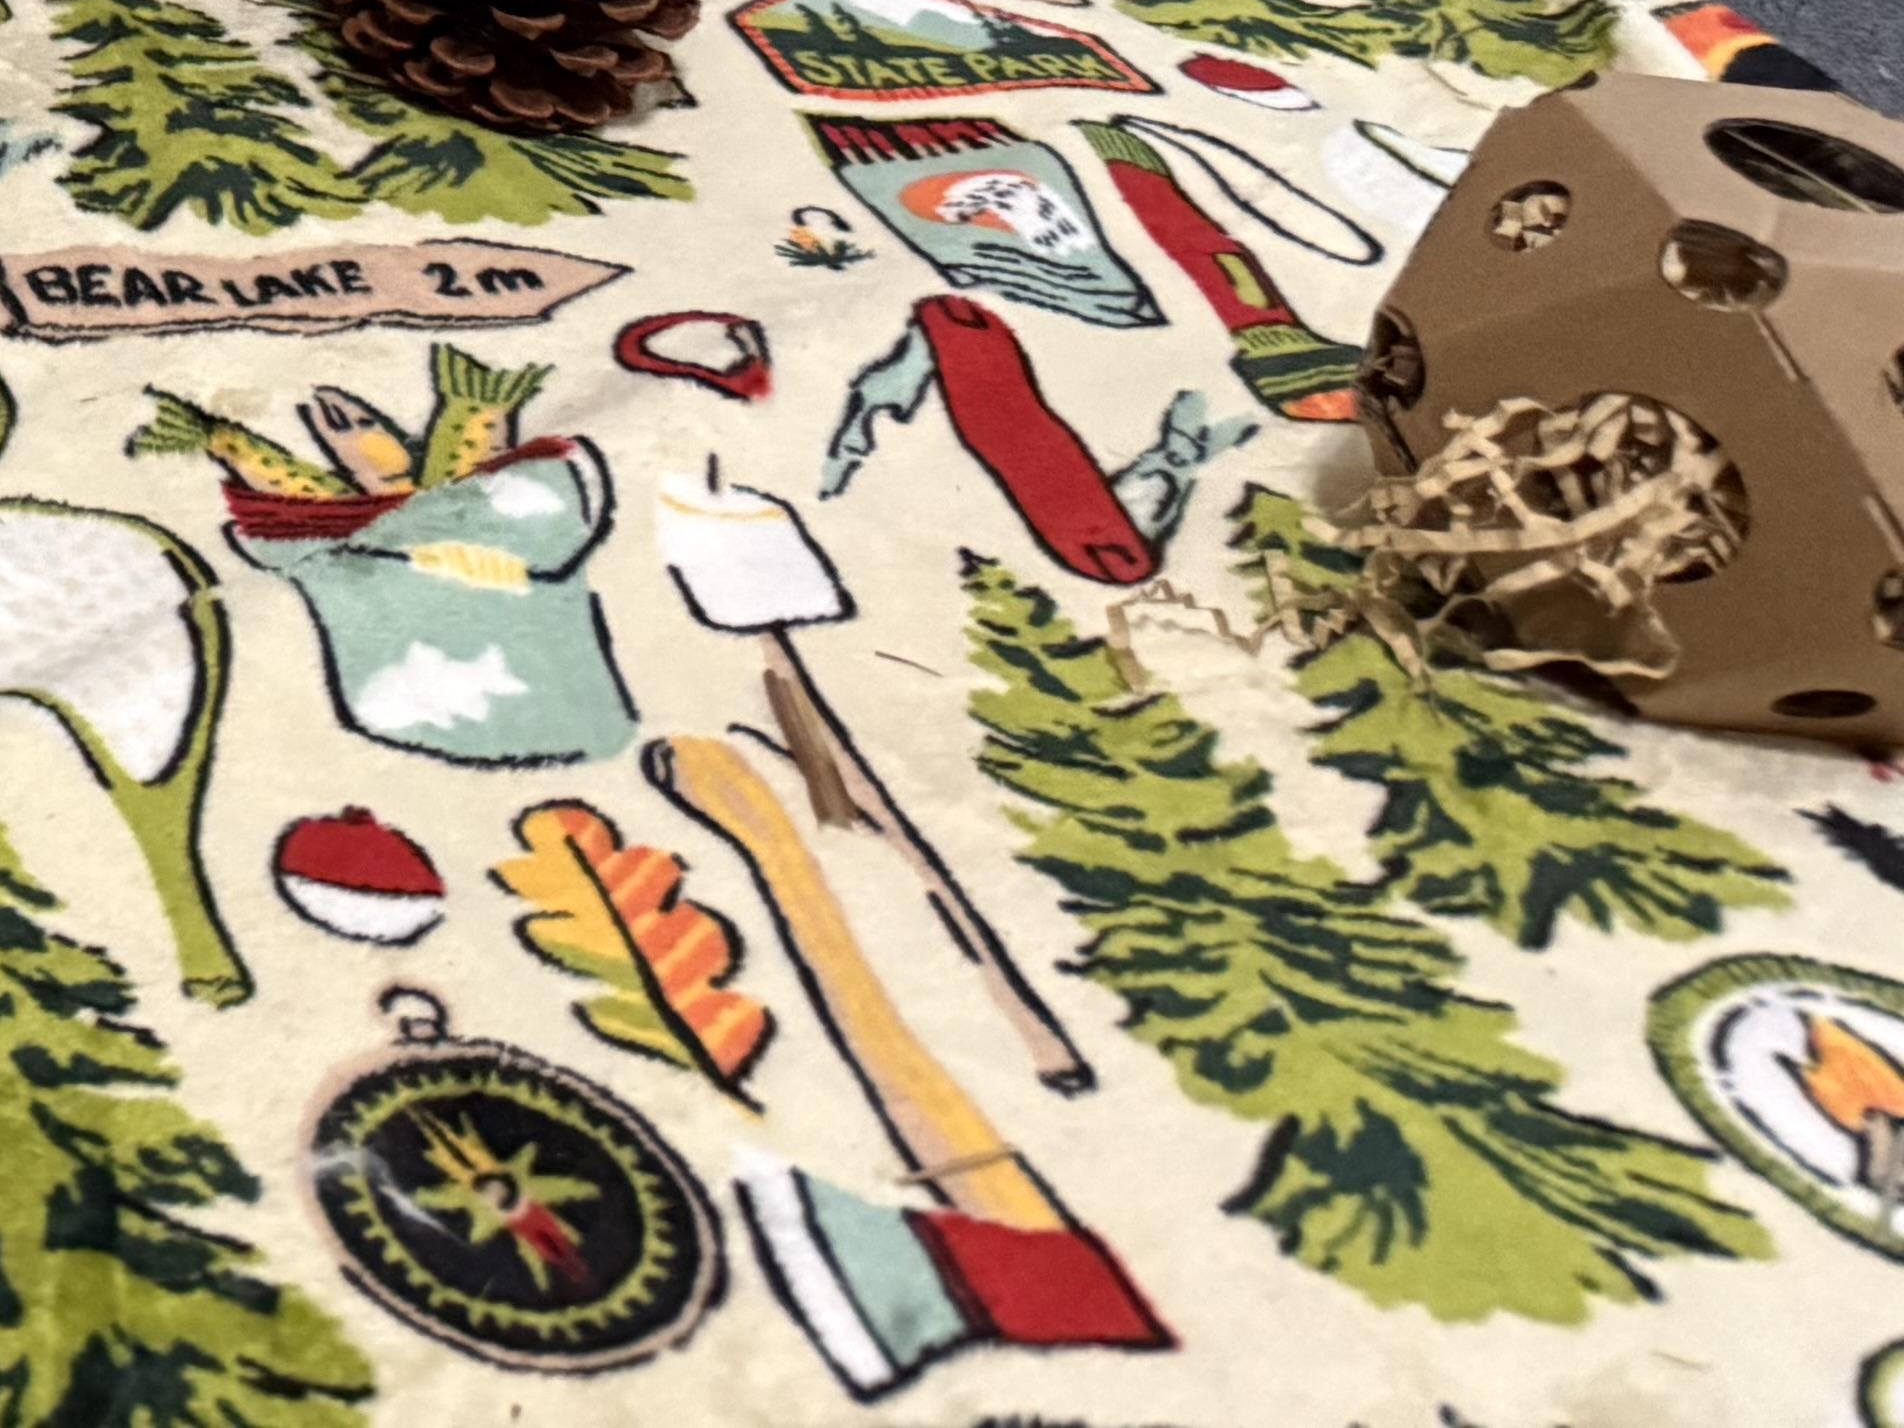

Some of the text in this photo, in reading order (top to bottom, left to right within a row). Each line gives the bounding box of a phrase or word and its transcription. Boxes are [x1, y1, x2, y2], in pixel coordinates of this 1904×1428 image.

[795, 49, 1129, 87] STATE PARK
[23, 262, 217, 308] BEAR
[220, 259, 373, 308] LAKE
